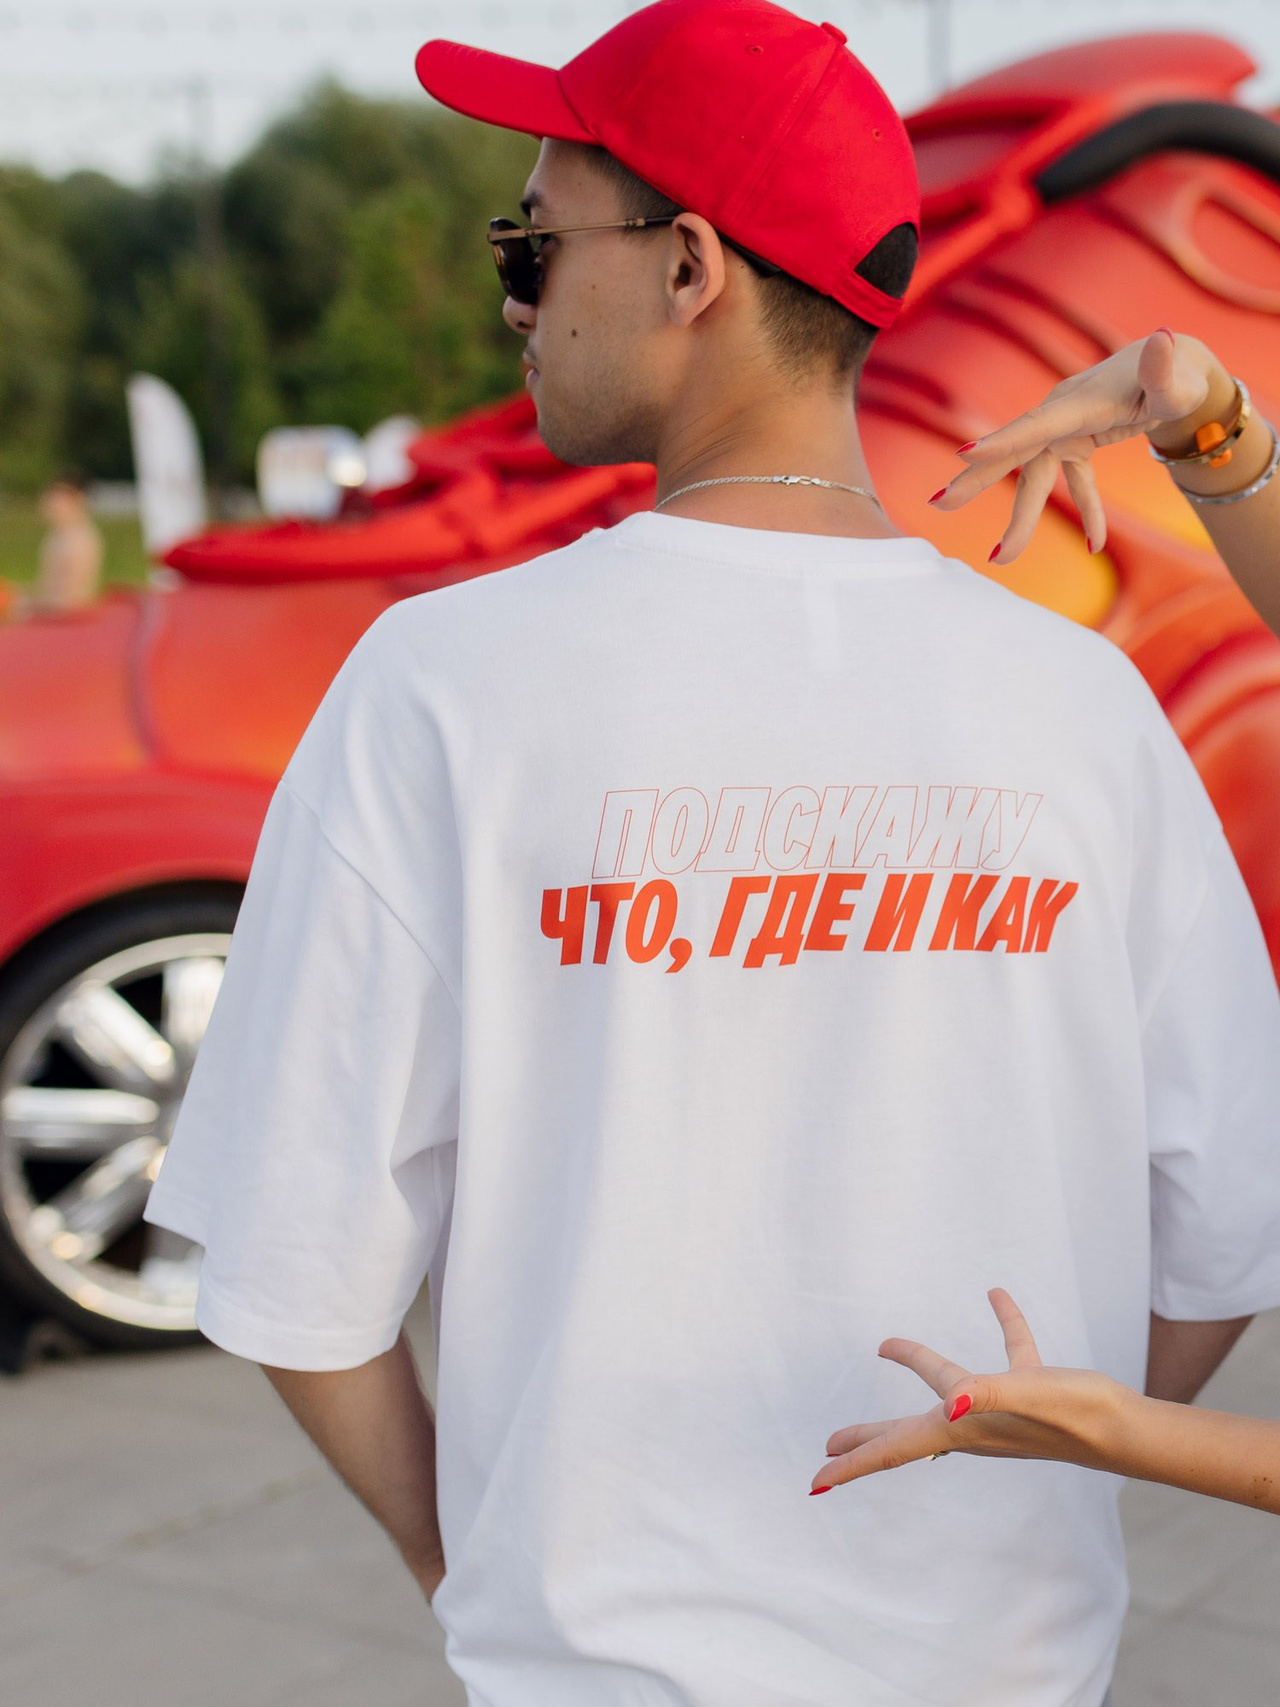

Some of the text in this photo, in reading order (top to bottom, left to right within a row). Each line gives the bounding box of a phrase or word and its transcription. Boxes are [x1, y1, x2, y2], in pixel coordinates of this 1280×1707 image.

[591, 785, 1044, 879] ПОДСКАЖУ
[540, 872, 1079, 974] ЧТО, ГДЕ И КАК
